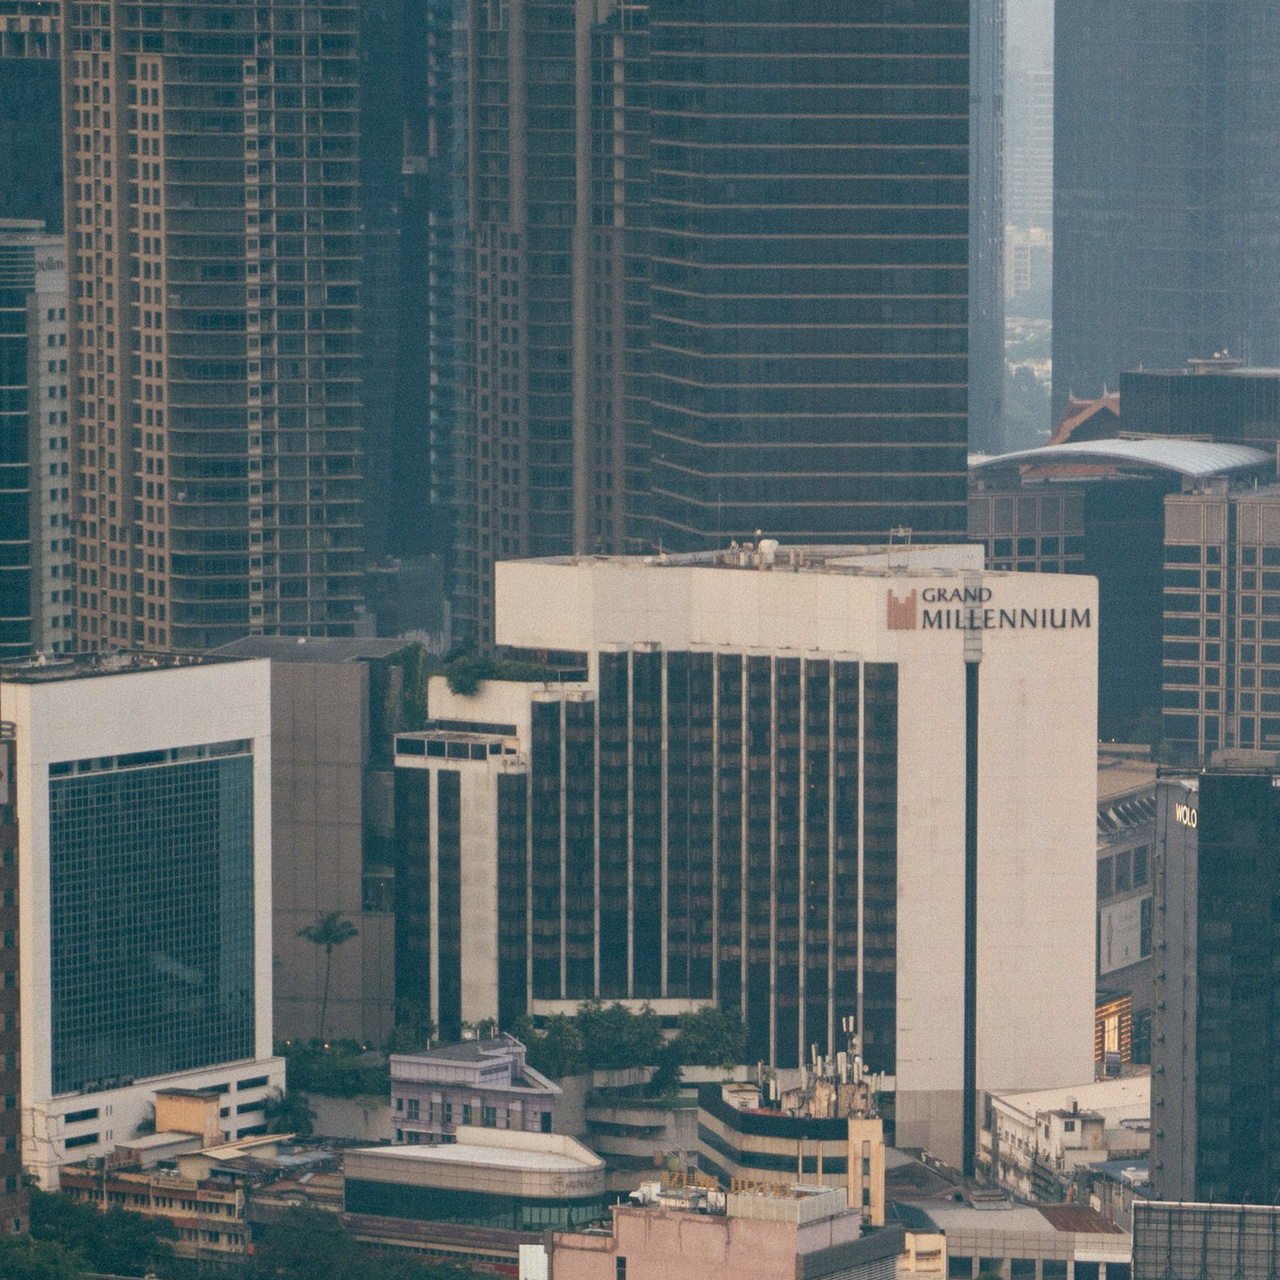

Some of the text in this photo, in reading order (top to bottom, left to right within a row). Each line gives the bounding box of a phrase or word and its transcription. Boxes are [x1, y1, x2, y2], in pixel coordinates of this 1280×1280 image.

[922, 587, 992, 603] GRAND
[922, 608, 1091, 629] MILLENNIUM
[1175, 802, 1197, 828] WOLO
